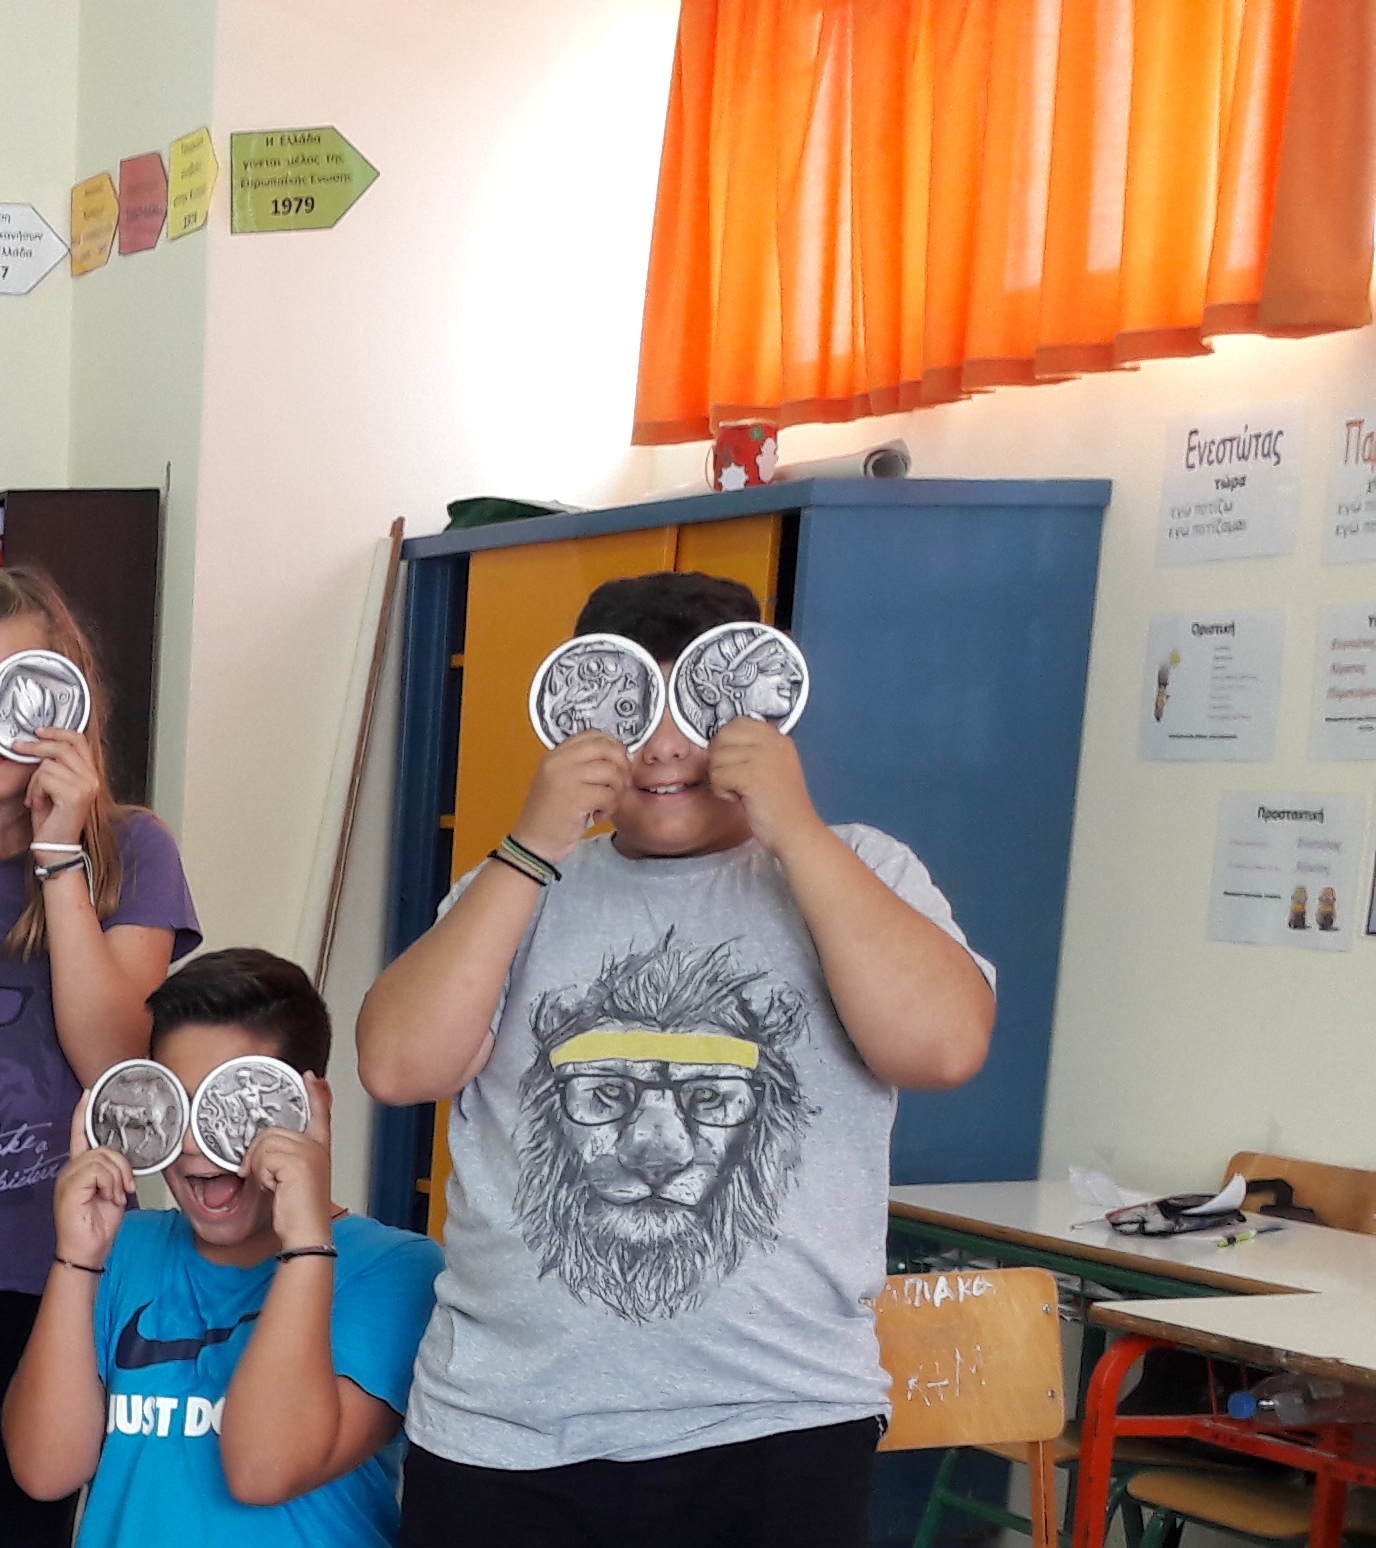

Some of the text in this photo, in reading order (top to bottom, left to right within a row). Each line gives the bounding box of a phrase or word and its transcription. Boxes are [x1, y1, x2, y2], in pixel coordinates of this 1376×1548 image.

[271, 196, 315, 216] 1979
[1185, 424, 1284, 470] Ενεστώτας
[107, 1394, 179, 1437] JUST
